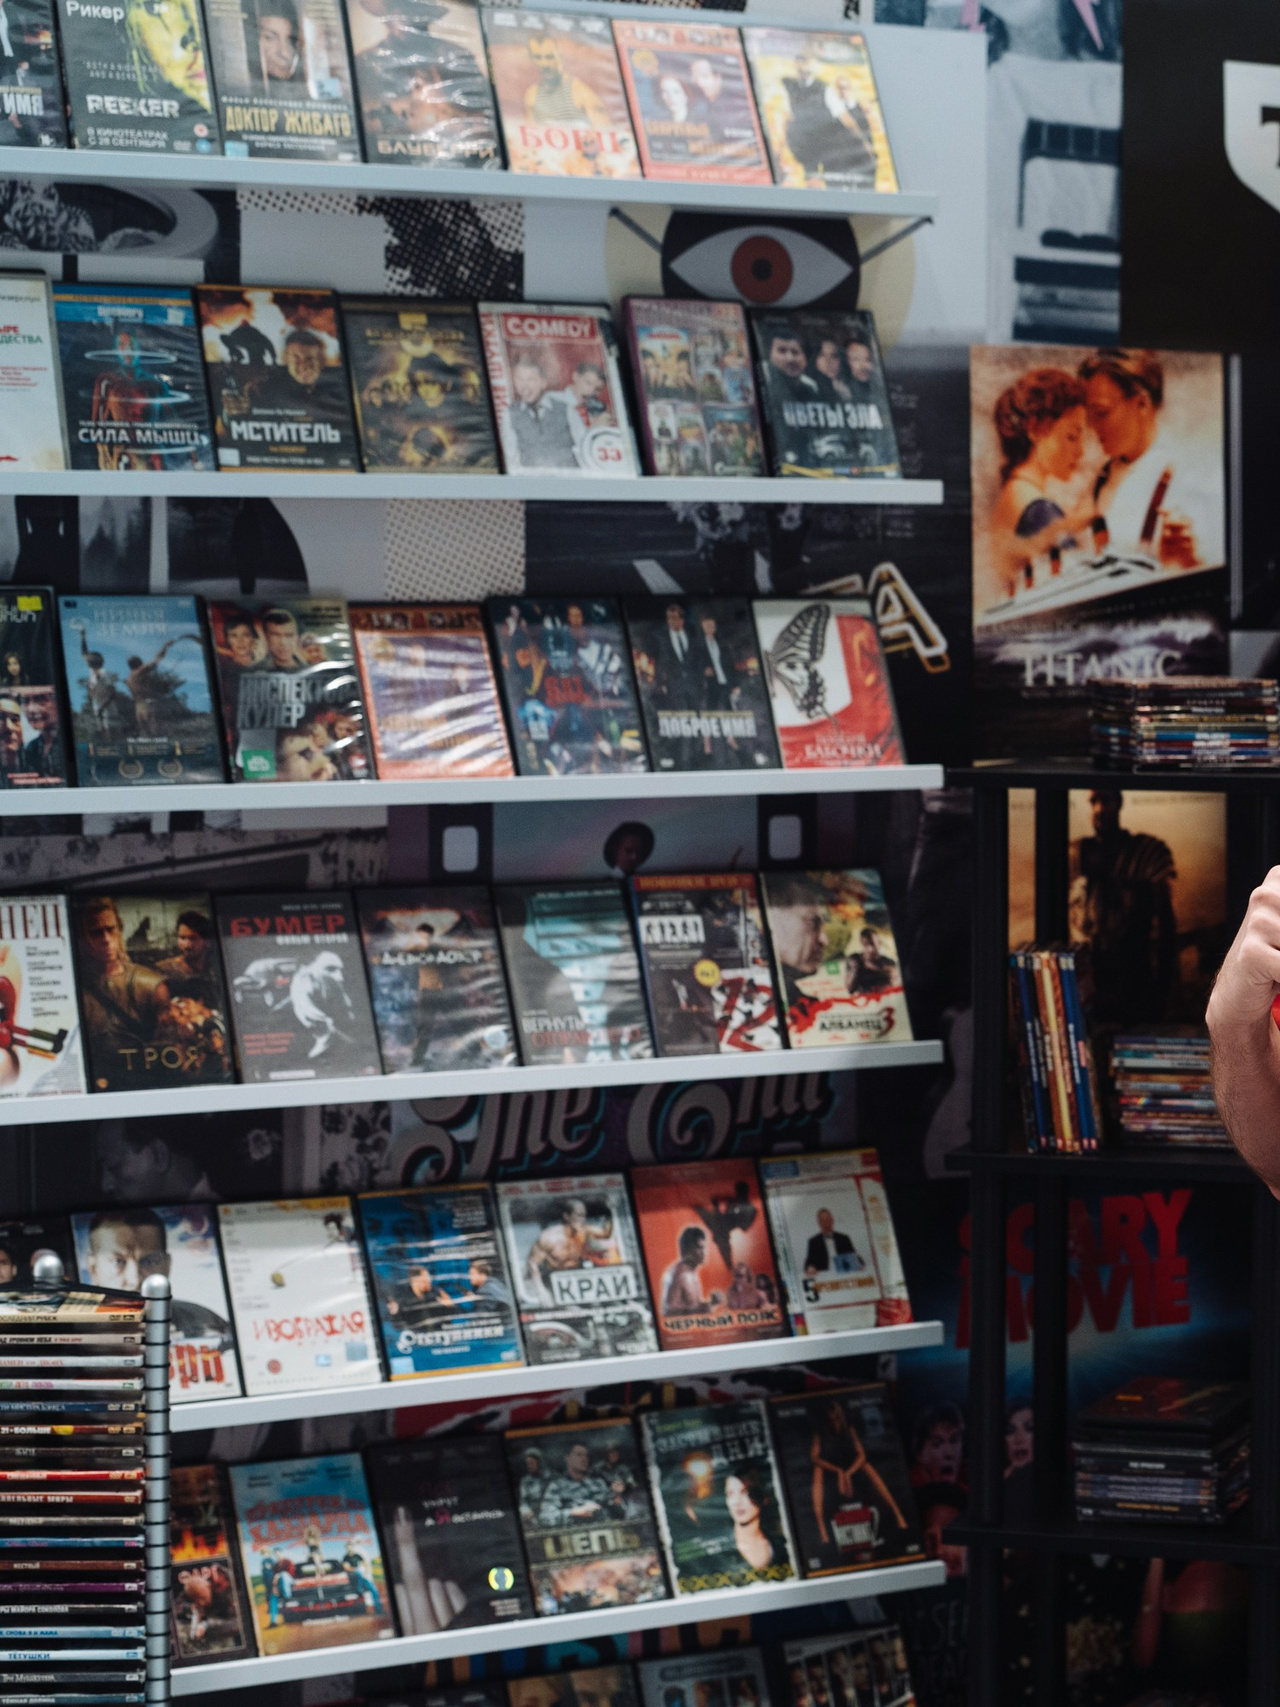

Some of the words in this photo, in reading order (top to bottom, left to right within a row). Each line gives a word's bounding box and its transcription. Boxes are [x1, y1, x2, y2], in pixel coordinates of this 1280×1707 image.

[66, 1, 124, 24] Рикер
[86, 95, 180, 118] REEKER
[226, 106, 279, 132] ДОКТОР
[284, 109, 351, 137] ЖИВАГО
[508, 316, 594, 337] COMEDY
[782, 402, 843, 427] ЦВЕТЫ
[846, 404, 883, 429] ЗЛА
[78, 428, 129, 443] СИЛА
[230, 421, 340, 443] МСТИТЕЛЬ
[598, 448, 623, 461] 33
[1023, 650, 1184, 687] TITANIC
[659, 716, 721, 739] ДОБРОЕ
[722, 717, 757, 738] ИМЯ
[230, 914, 345, 937] БУМЕР
[820, 1019, 882, 1031] АЛБАНЕЦ
[876, 1007, 896, 1038] 3
[118, 1047, 200, 1072] ТРОЯ
[803, 1278, 820, 1302] 5
[664, 1313, 732, 1330] ЧЕРНЫЙ
[737, 1309, 780, 1323] ПОЯС
[543, 1529, 641, 1558] ЦЕПЬ
